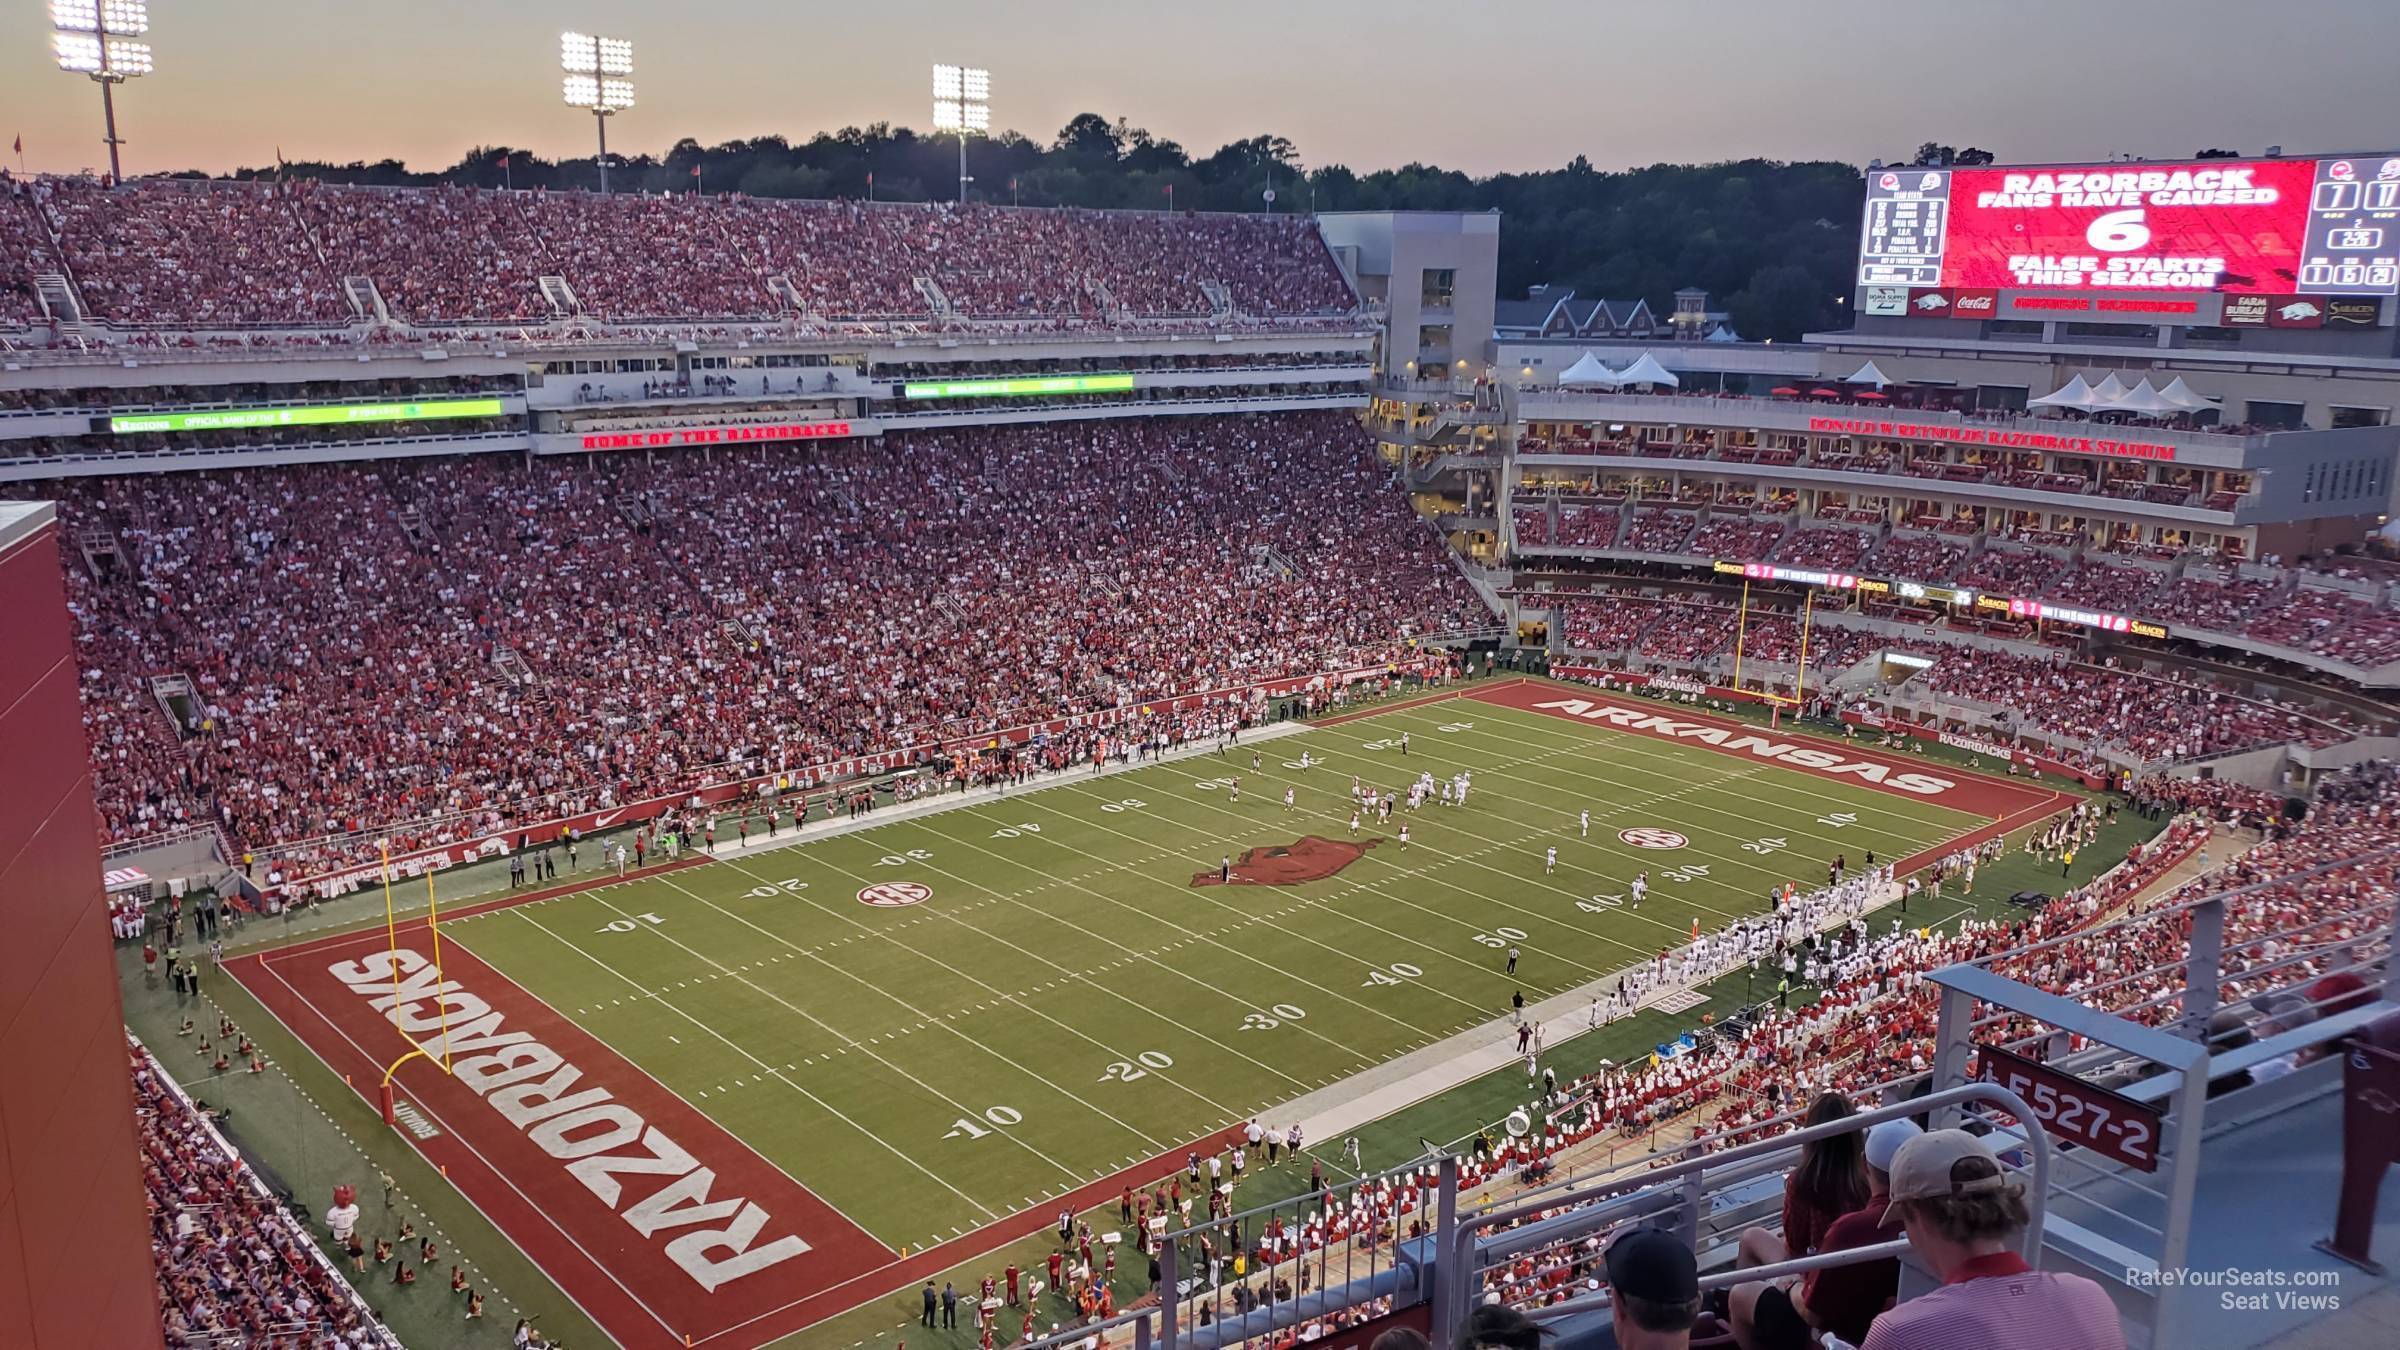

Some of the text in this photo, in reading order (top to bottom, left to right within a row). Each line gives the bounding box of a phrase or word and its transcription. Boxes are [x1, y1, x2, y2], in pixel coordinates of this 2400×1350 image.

[2004, 170, 2255, 194] RAZORBACK
[1977, 187, 2279, 209] FANS HAVE CAUSED
[2331, 184, 2345, 208] 7
[2379, 183, 2399, 208] 17
[2086, 208, 2151, 252] 6
[2008, 256, 2226, 273] FALSE STARTS
[2014, 270, 2215, 288] THIS SEASON
[2226, 305, 2267, 315] BUREAU
[2238, 296, 2267, 306] FARM
[582, 423, 851, 449] HOME OF THE RAZORBACKS
[1987, 430, 2094, 453] RAZORBACK
[2096, 440, 2176, 461] STADIUM
[1977, 595, 2010, 611] SARACEN
[2131, 620, 2166, 635] SARACEN
[1648, 677, 1706, 695] ARKANSAS
[1532, 699, 1956, 795] ARKANSAS
[1939, 732, 2013, 760] RAZORBACKS
[1101, 799, 1149, 813] 50
[996, 822, 1041, 838] 40
[1817, 812, 1856, 828] 10
[1740, 837, 1786, 855] 20
[881, 849, 933, 866] 30
[1661, 865, 1708, 883] 30
[751, 878, 808, 897] 20
[1575, 894, 1623, 914] 40
[608, 912, 667, 933] 10
[1472, 927, 1529, 949] 50
[1370, 963, 1424, 987] 40
[1244, 1004, 1307, 1031] 30
[1106, 1051, 1174, 1083] 20
[327, 948, 813, 1294] RAZORBACKS
[952, 1106, 1023, 1140] 10
